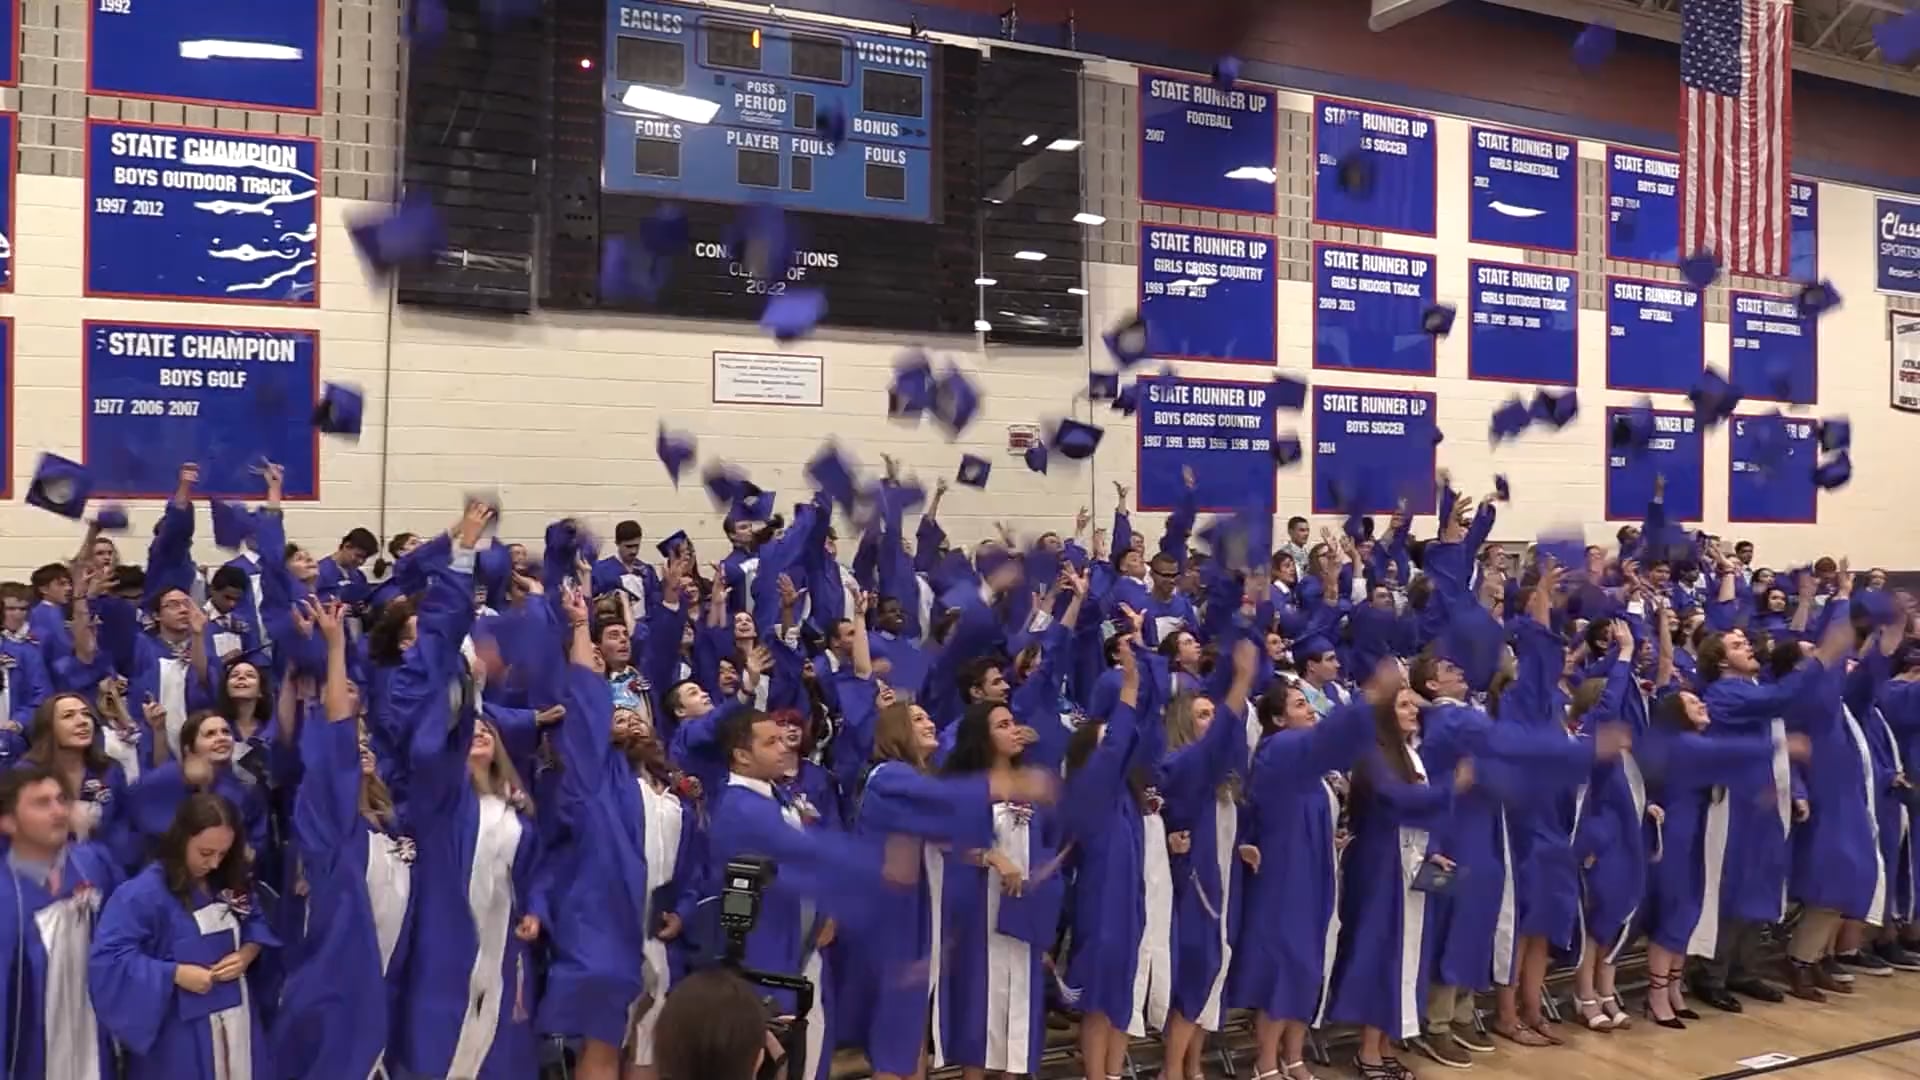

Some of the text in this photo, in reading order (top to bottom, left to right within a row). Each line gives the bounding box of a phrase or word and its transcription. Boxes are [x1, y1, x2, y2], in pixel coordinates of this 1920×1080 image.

[99, 0, 131, 14] 1992
[620, 7, 683, 34] EAGLES
[856, 41, 928, 69] VISITOR
[747, 81, 775, 95] POSS
[1151, 79, 1267, 112] STATE RUNNER UP
[735, 93, 787, 113] PERIOD
[635, 120, 682, 139] FOULS
[853, 118, 899, 137] BONUS
[1186, 110, 1233, 129] FOOTBALL
[1362, 112, 1409, 136] RUNNER
[1412, 120, 1428, 138] UP
[726, 130, 835, 156] PLAYER FOULS
[1145, 129, 1165, 142] 2007
[111, 132, 297, 168] STATE CHAMPION
[864, 146, 906, 165] FOULS
[1373, 138, 1408, 155] SOCCER
[1478, 132, 1570, 160] STATE RUNNER UP
[1489, 157, 1560, 179] GIRLS BASKETBALL
[1614, 155, 1643, 173] STATE
[114, 167, 292, 196] BOYS OUTDOOR TRACK
[1637, 180, 1675, 196] BOYS GOLF
[95, 198, 164, 216] 1997 2012
[1150, 232, 1267, 259] STATE RUNNER UP
[1154, 258, 1263, 281] GIRLS CROSS COUNTRY
[1324, 250, 1428, 277] STATE RUNNER UP
[787, 267, 807, 281] OF
[1478, 268, 1570, 292] STATE RUNNER UP
[1331, 276, 1420, 297] GIRLS INDOOR TRACK
[1614, 283, 1697, 307] STATE RUNNER UP
[1481, 291, 1568, 311] GIRLS OUTDOOR TRACK
[1737, 298, 1763, 315] STATE
[1640, 308, 1673, 322] SOFTBALL
[109, 332, 295, 362] STATE CHAMPION
[160, 368, 247, 388] BOYS GOLF
[1149, 384, 1266, 408] STATE RUNNER UP
[1323, 394, 1427, 415] STATE RUNNER UP
[94, 399, 200, 416] 1977 2006 2007
[1154, 411, 1261, 429] BOYS CROSS COUNTRY
[1346, 420, 1405, 435] BOYS SOCCER
[1683, 418, 1695, 433] UP
